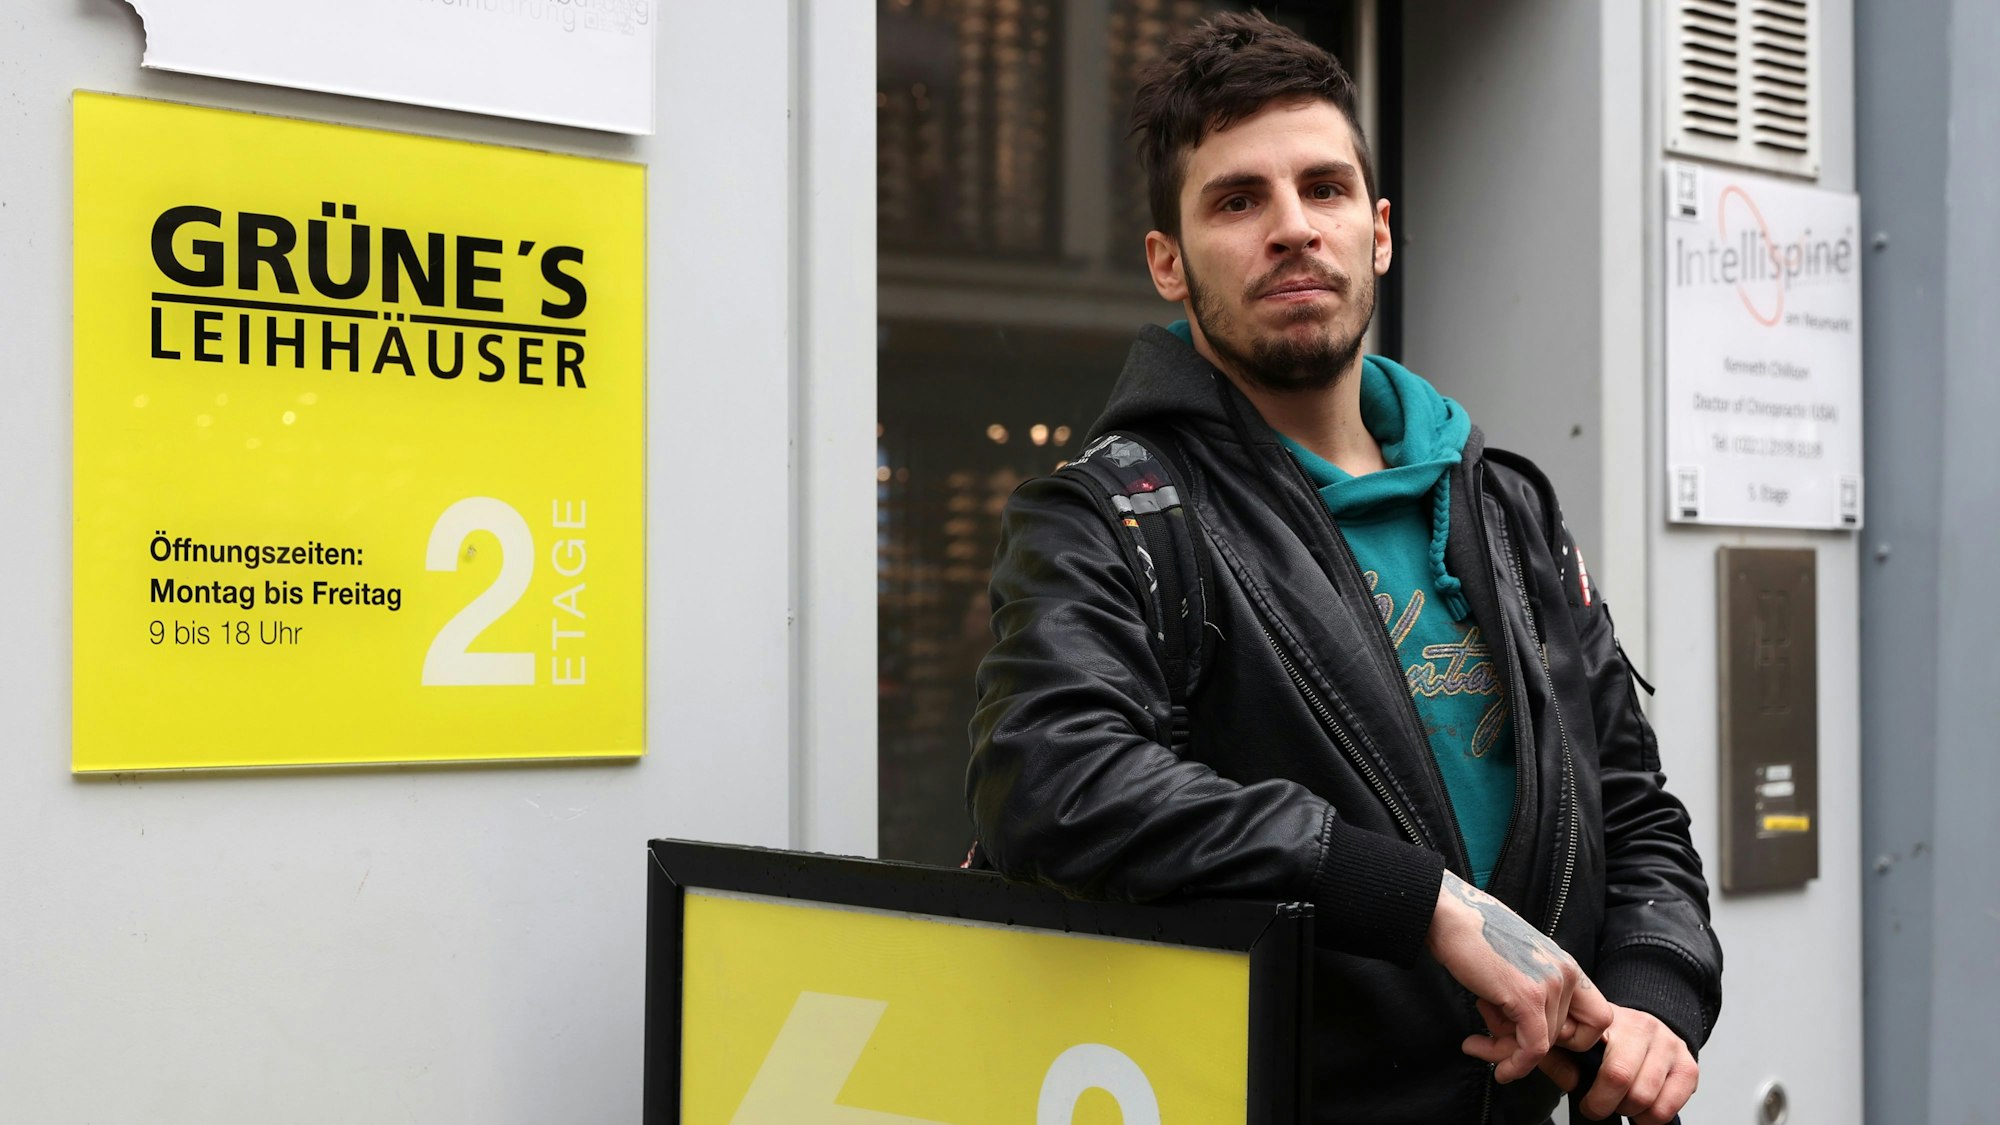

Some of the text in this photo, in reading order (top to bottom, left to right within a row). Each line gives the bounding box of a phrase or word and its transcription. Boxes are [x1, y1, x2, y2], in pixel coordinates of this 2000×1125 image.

[1677, 229, 1851, 291] Intellispine
[151, 307, 587, 389] LEIHHÄUSER
[1693, 393, 1729, 413] Doctor
[1733, 398, 1745, 414] of
[150, 530, 364, 570] Öffnungszeiten:
[150, 578, 402, 612] Montag bis Freitag
[421, 496, 587, 686] 2 ETAGE
[149, 619, 303, 645] 9 bis 18 Uhr
